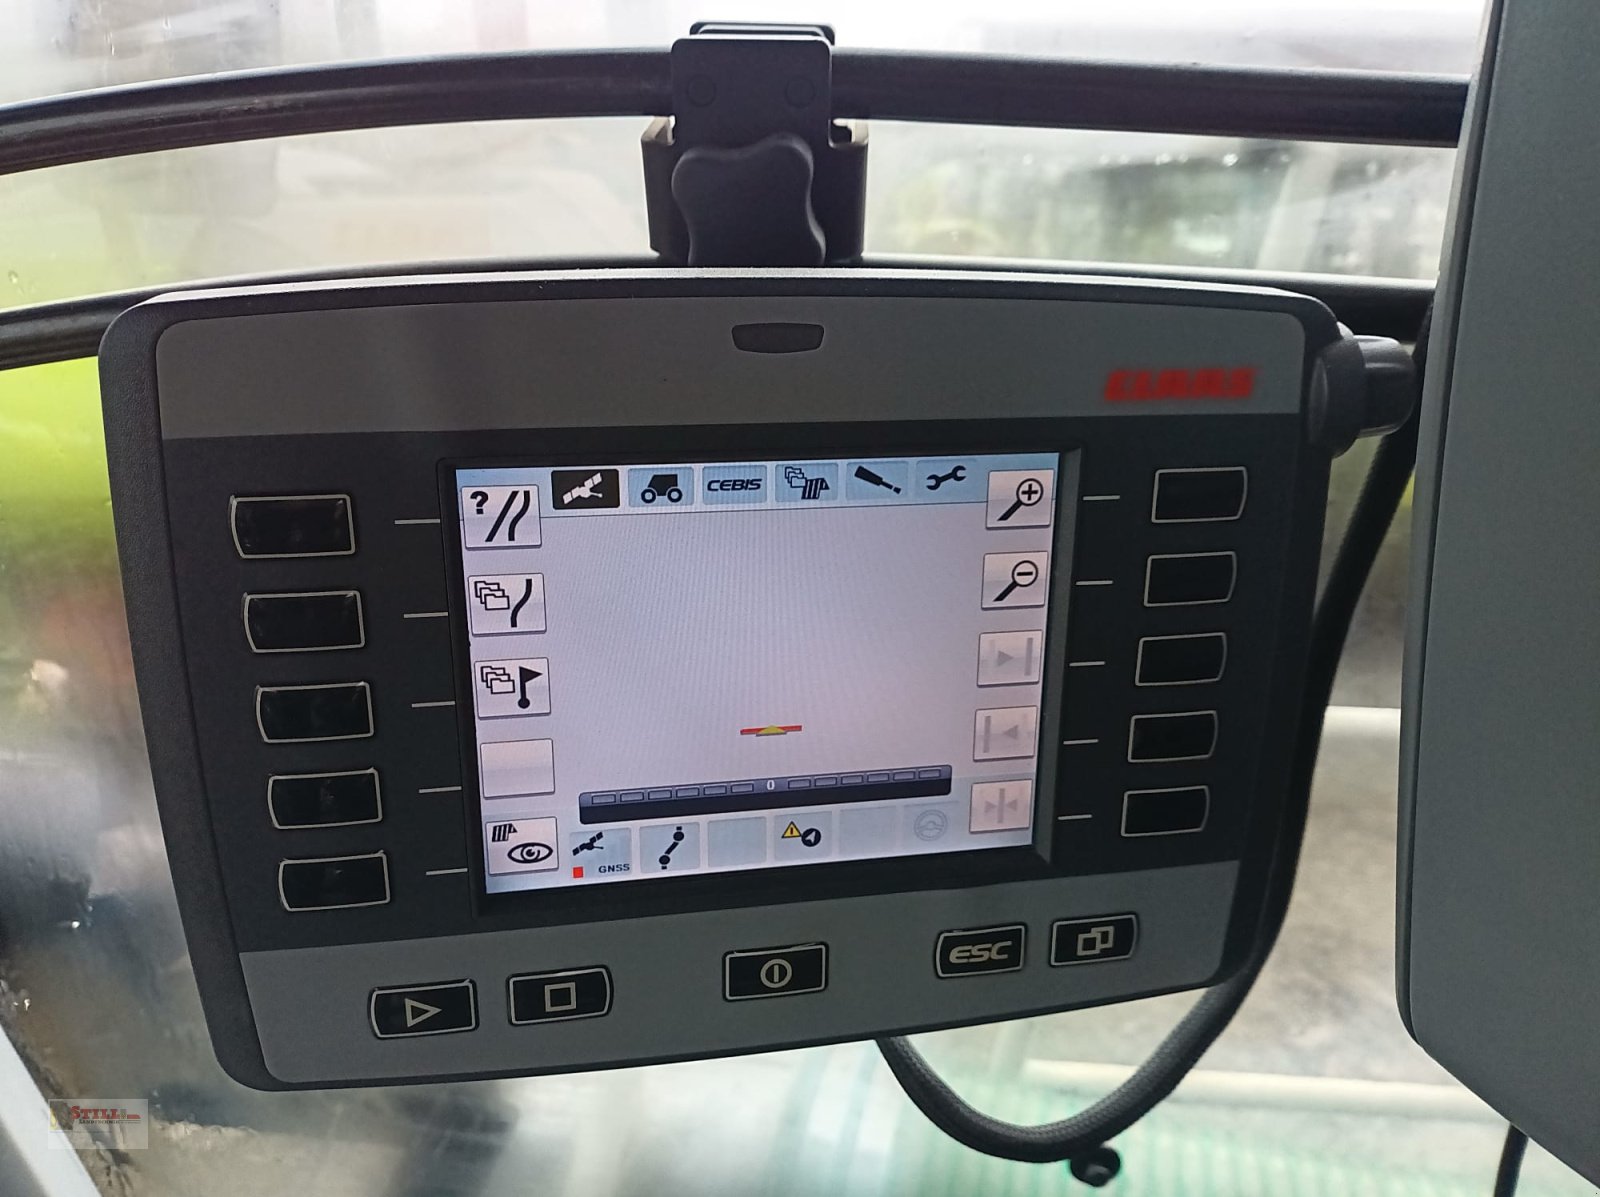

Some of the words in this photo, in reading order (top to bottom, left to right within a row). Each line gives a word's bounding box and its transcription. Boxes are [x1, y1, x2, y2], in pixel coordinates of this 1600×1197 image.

[707, 478, 763, 492] CEBIS
[598, 863, 630, 873] GNSS
[949, 940, 1013, 964] ESC
